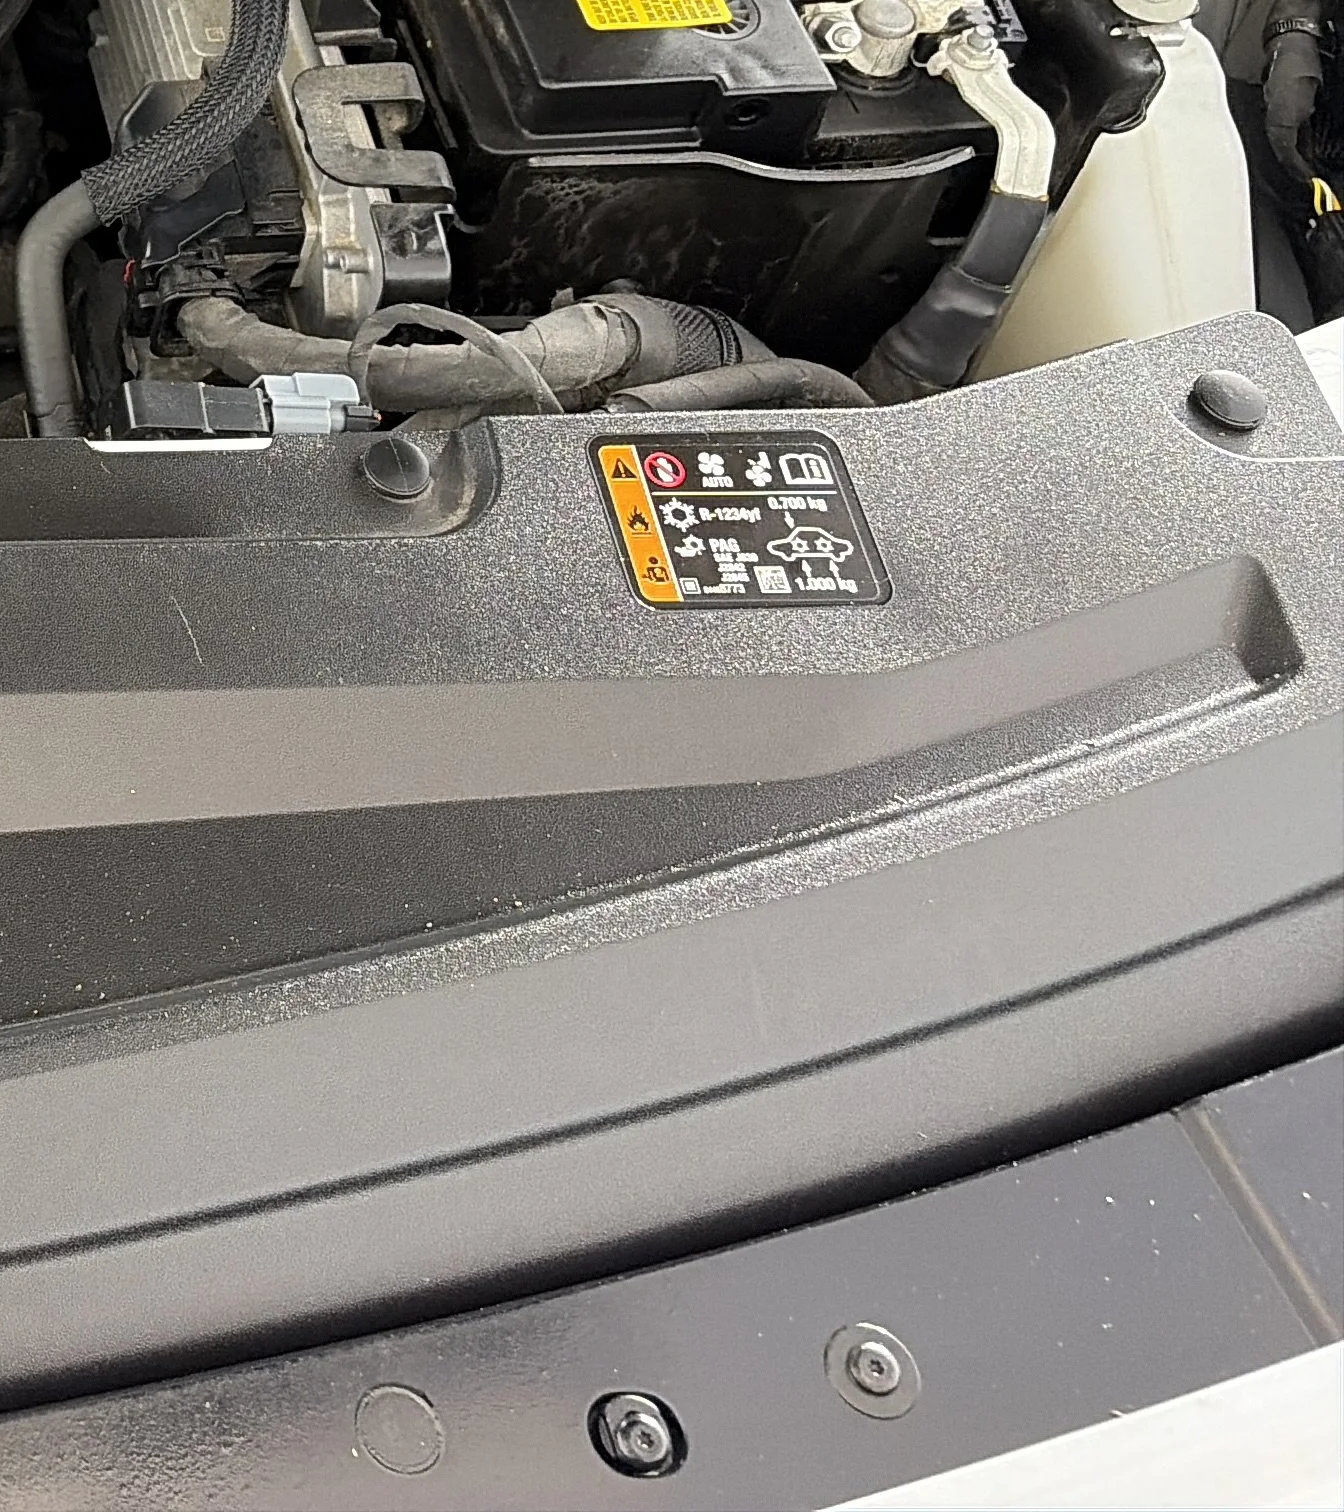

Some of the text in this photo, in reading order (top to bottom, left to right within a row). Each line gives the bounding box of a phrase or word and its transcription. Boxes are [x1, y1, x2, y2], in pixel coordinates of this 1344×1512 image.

[702, 476, 734, 487] AUTO
[767, 496, 828, 512] 0.700 kg
[698, 507, 761, 523] R-1234yf
[708, 538, 741, 552] PAG
[794, 577, 859, 593] 1.000 kg
